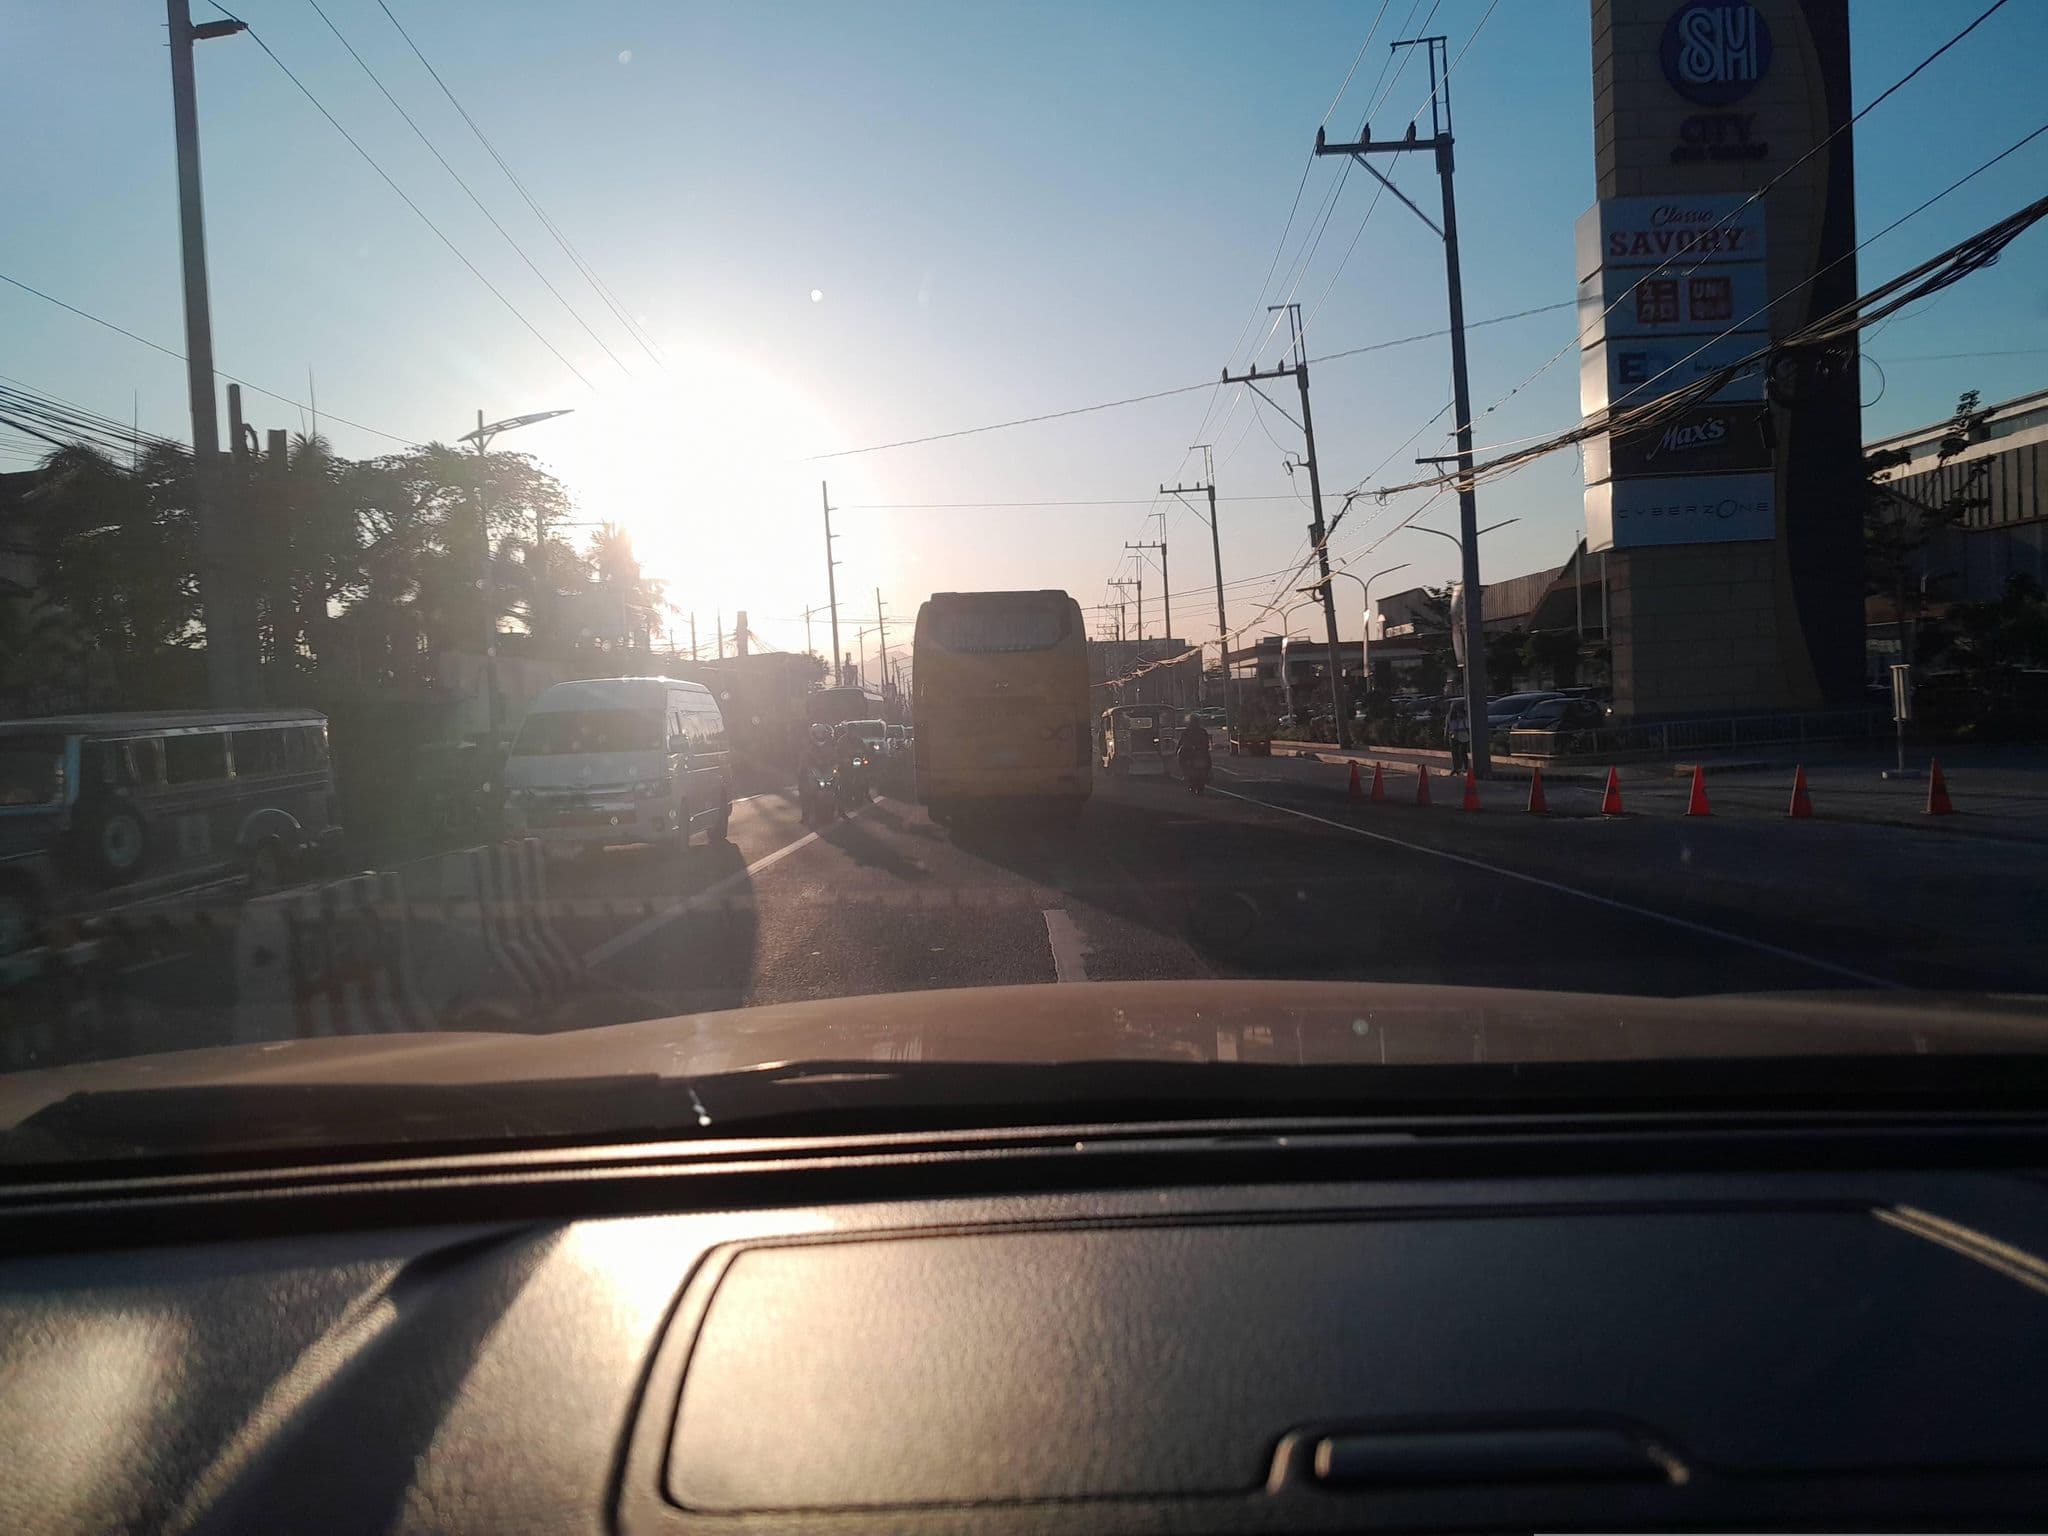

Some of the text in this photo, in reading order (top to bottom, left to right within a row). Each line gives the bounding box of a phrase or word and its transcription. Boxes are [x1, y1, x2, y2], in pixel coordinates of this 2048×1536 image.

[1678, 6, 1757, 83] SM
[1608, 227, 1744, 256] SAVORY
[1645, 418, 1726, 460] Max's
[1615, 498, 1769, 520] CYBERZONE
